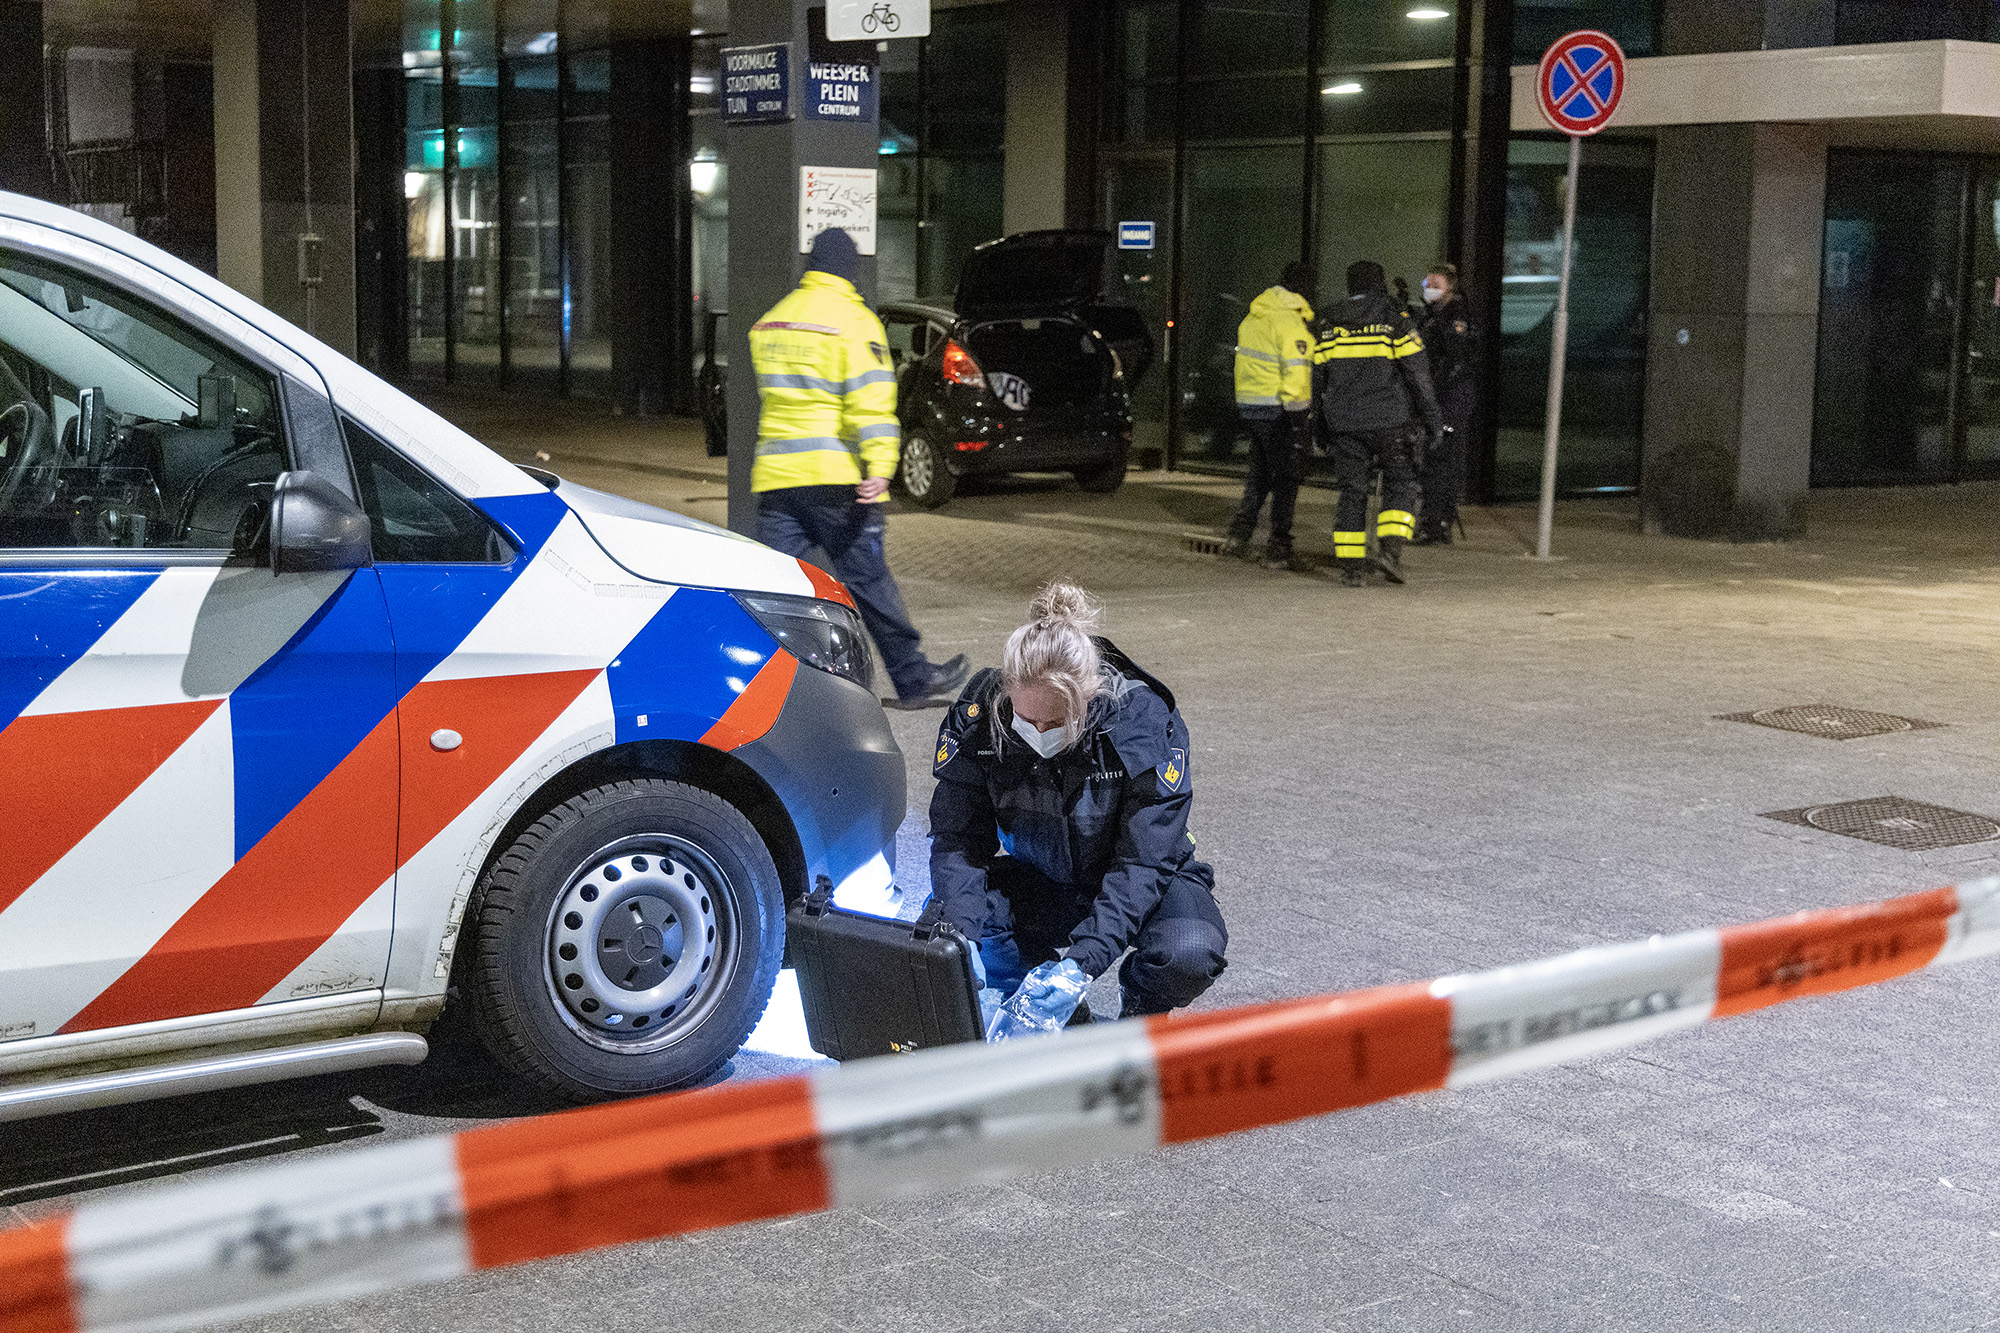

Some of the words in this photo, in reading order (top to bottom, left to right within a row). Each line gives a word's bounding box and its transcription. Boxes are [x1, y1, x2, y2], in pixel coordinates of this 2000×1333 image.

[810, 63, 870, 82] WEESPER
[726, 73, 782, 93] STADSTIMMER
[820, 83, 859, 102] PLEIN
[727, 97, 748, 114] TUIN
[817, 103, 860, 116] CENTRUM
